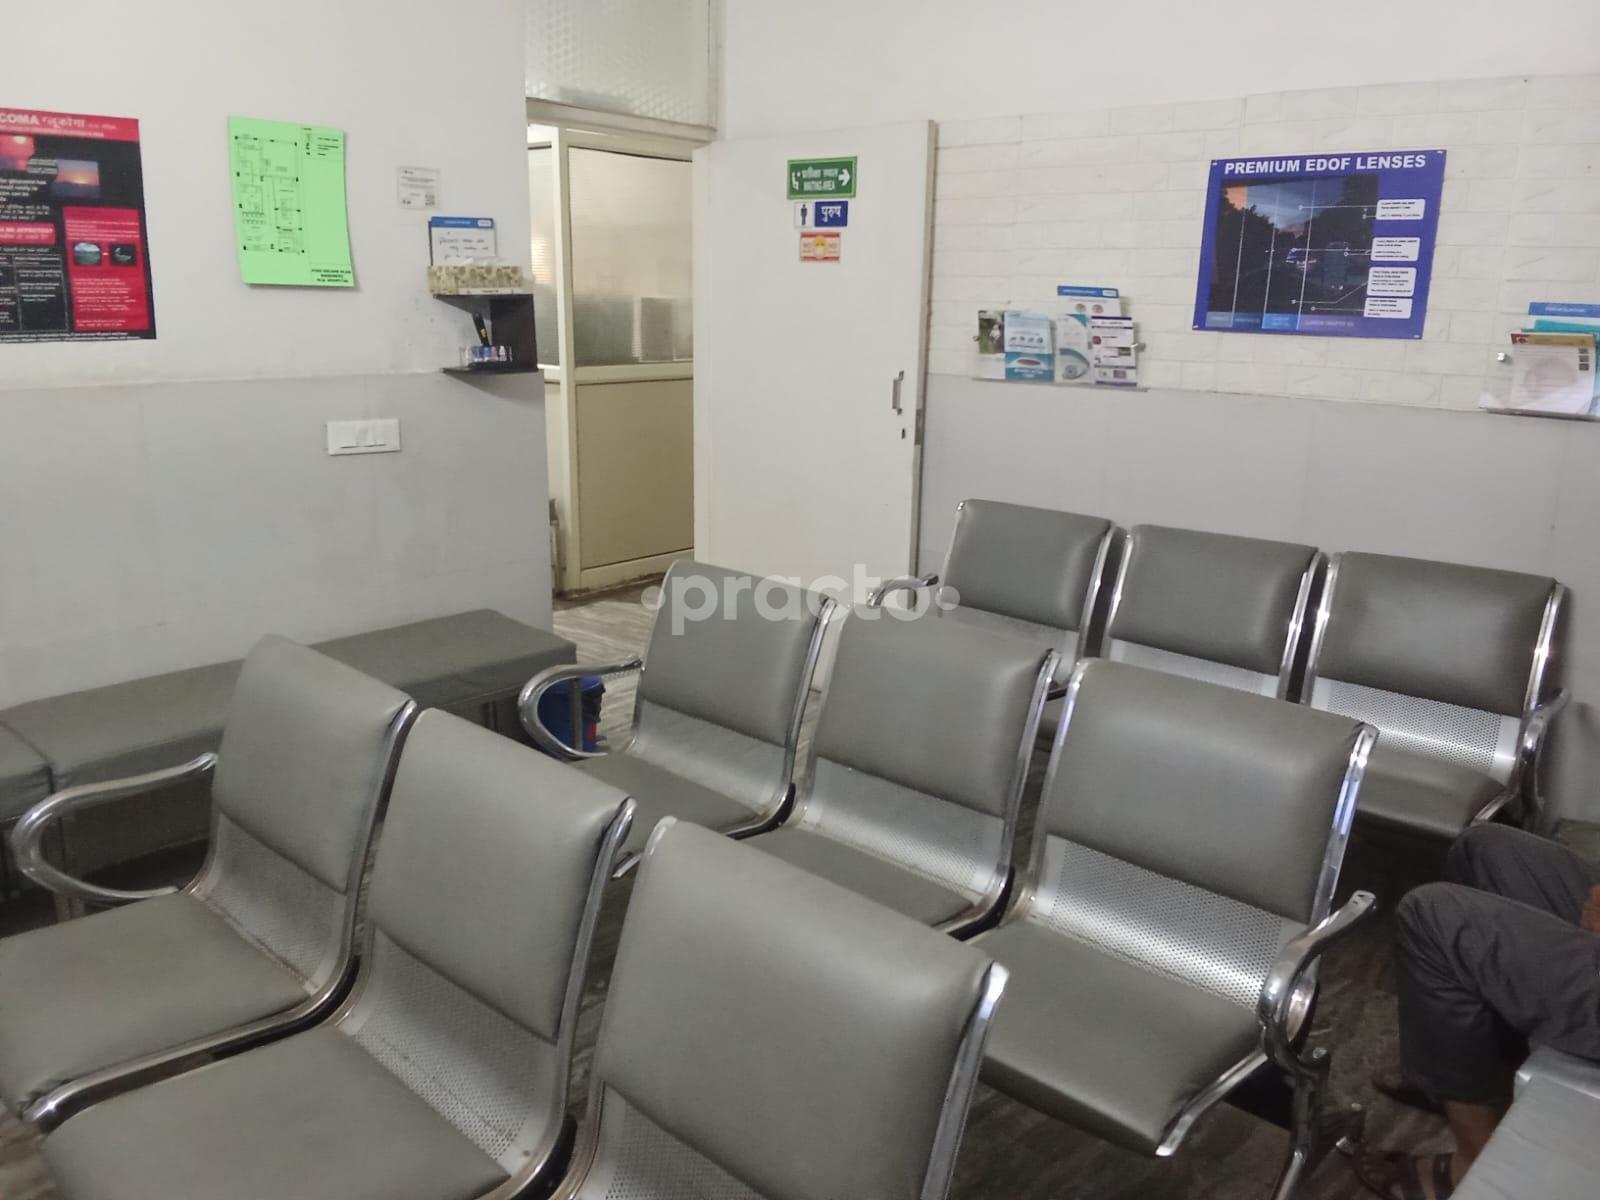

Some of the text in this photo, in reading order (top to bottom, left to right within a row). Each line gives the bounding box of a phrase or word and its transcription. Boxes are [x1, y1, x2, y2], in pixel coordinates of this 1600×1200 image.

[1224, 155, 1426, 174] PREMIUM EDOF LENSES
